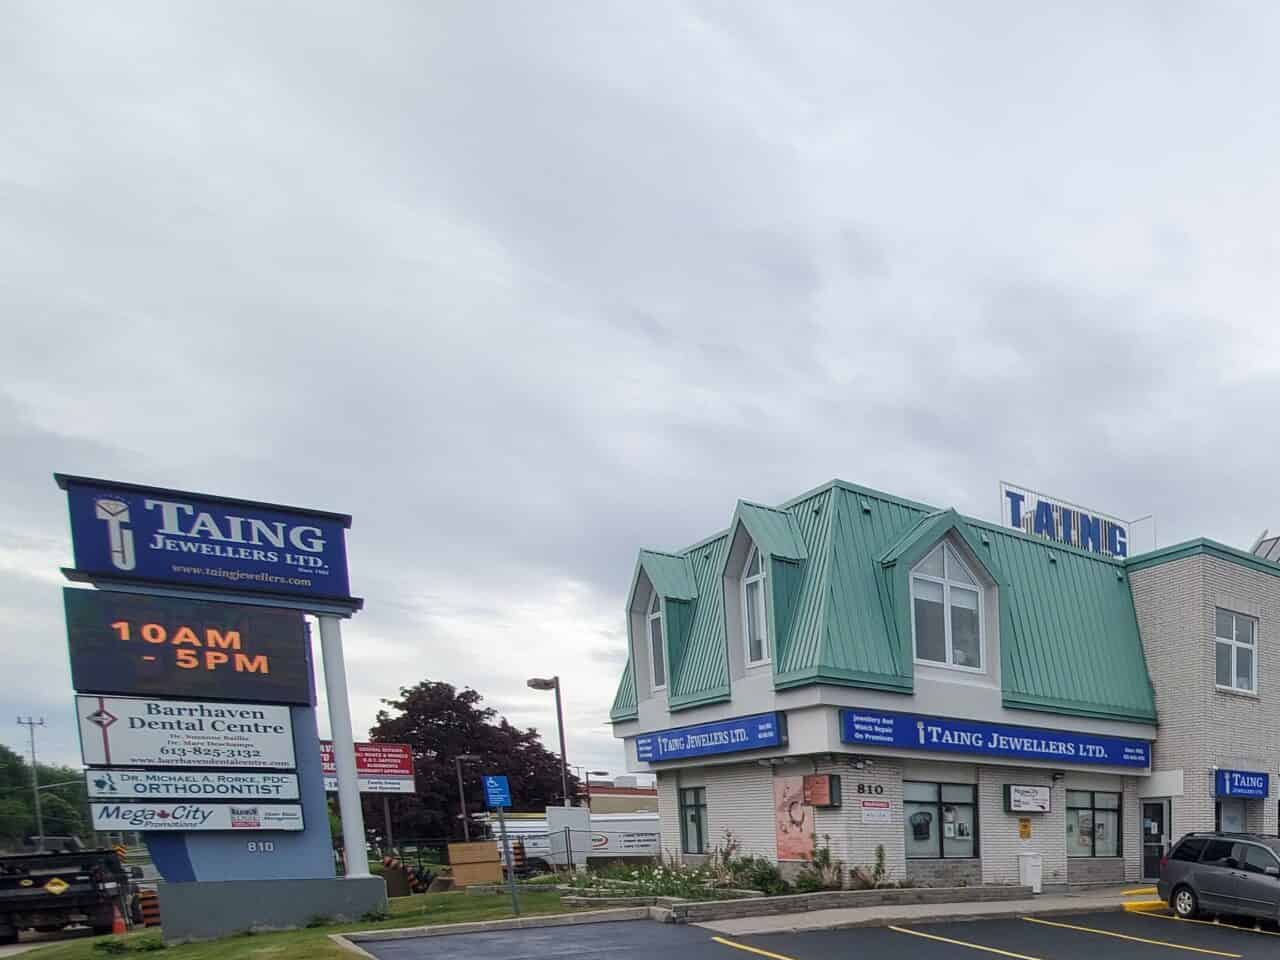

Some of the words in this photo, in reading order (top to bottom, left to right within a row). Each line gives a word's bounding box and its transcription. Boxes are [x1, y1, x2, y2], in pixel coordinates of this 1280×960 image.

[143, 499, 327, 553] TAING
[1005, 490, 1128, 558] TAING
[150, 534, 279, 563] JEWELLERS
[285, 553, 329, 569] LTD.
[111, 621, 241, 650] 10AM
[175, 649, 270, 674] 5PM
[146, 703, 265, 720] Barrhaven
[128, 716, 204, 731] Dental
[211, 719, 285, 734] Centre
[662, 737, 685, 752] TAING
[686, 731, 730, 750] JEWELLERS
[927, 725, 983, 747] TAING
[988, 732, 1075, 755] JEWELLERS
[1079, 744, 1108, 759] LTD.
[160, 746, 261, 758] 613-825-3132
[146, 774, 201, 783] MICHAEL
[1231, 773, 1264, 788] TAING
[133, 783, 283, 795] ORTHODONTIST
[857, 783, 884, 795] 810
[98, 805, 155, 826] Mega
[172, 804, 214, 825] City
[144, 820, 199, 829] Promotions
[247, 841, 275, 852] 810
